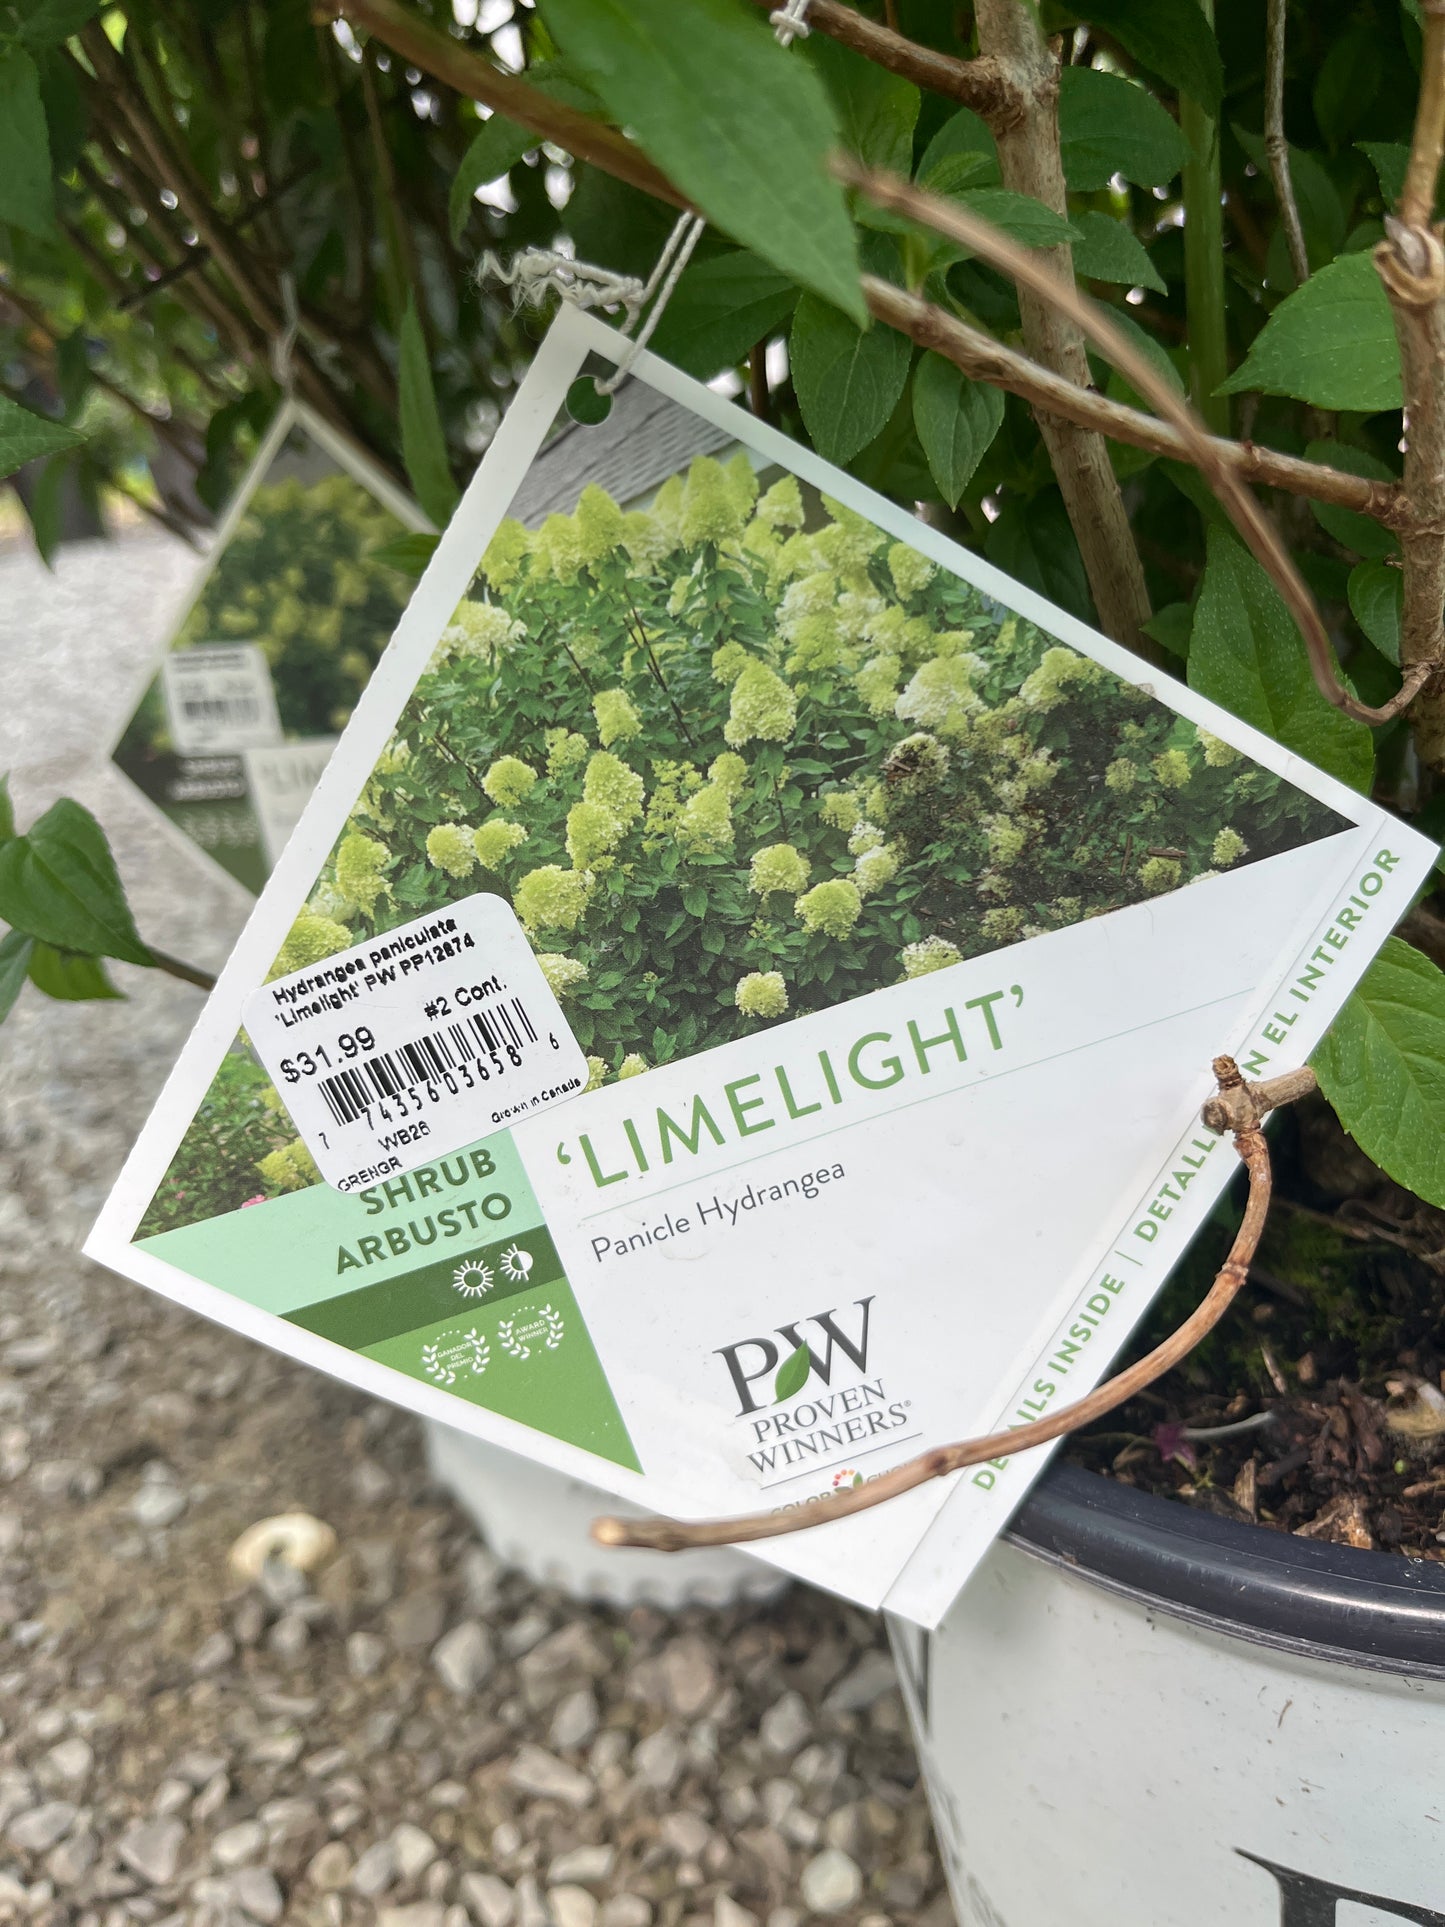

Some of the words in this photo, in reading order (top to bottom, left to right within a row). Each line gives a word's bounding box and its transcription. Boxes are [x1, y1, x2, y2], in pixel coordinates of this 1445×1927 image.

[272, 958, 366, 1005] Hydrangea
[370, 919, 457, 968] paniculata
[364, 965, 396, 991] PW
[399, 932, 475, 976] PP12874
[424, 996, 452, 1021] #2
[454, 975, 507, 1006] Cont.
[280, 1026, 376, 1083] $31.99
[491, 1102, 528, 1123] Grown
[530, 1096, 540, 1107] in
[541, 1078, 581, 1101] Canada
[378, 1120, 431, 1152] WB26
[360, 1149, 497, 1215] SHRUB
[971, 1379, 1055, 1490] DEILS
[1047, 1273, 1125, 1374] INSIDE
[1133, 1124, 1224, 1242] DETALL
[1261, 1012, 1299, 1045] EL
[1288, 849, 1401, 1003] INTERIOR
[337, 1192, 512, 1275] ARBUSTO
[590, 1213, 691, 1262] Panicle
[696, 1162, 846, 1225] Hydrangea
[437, 1341, 473, 1358] GANADOR
[515, 1319, 545, 1336] AWARD
[518, 1326, 548, 1342] WINNER
[712, 1295, 876, 1417] PW
[446, 1356, 474, 1370] PREMIO
[450, 1353, 465, 1362] DEL
[751, 1378, 887, 1444] PROVEN
